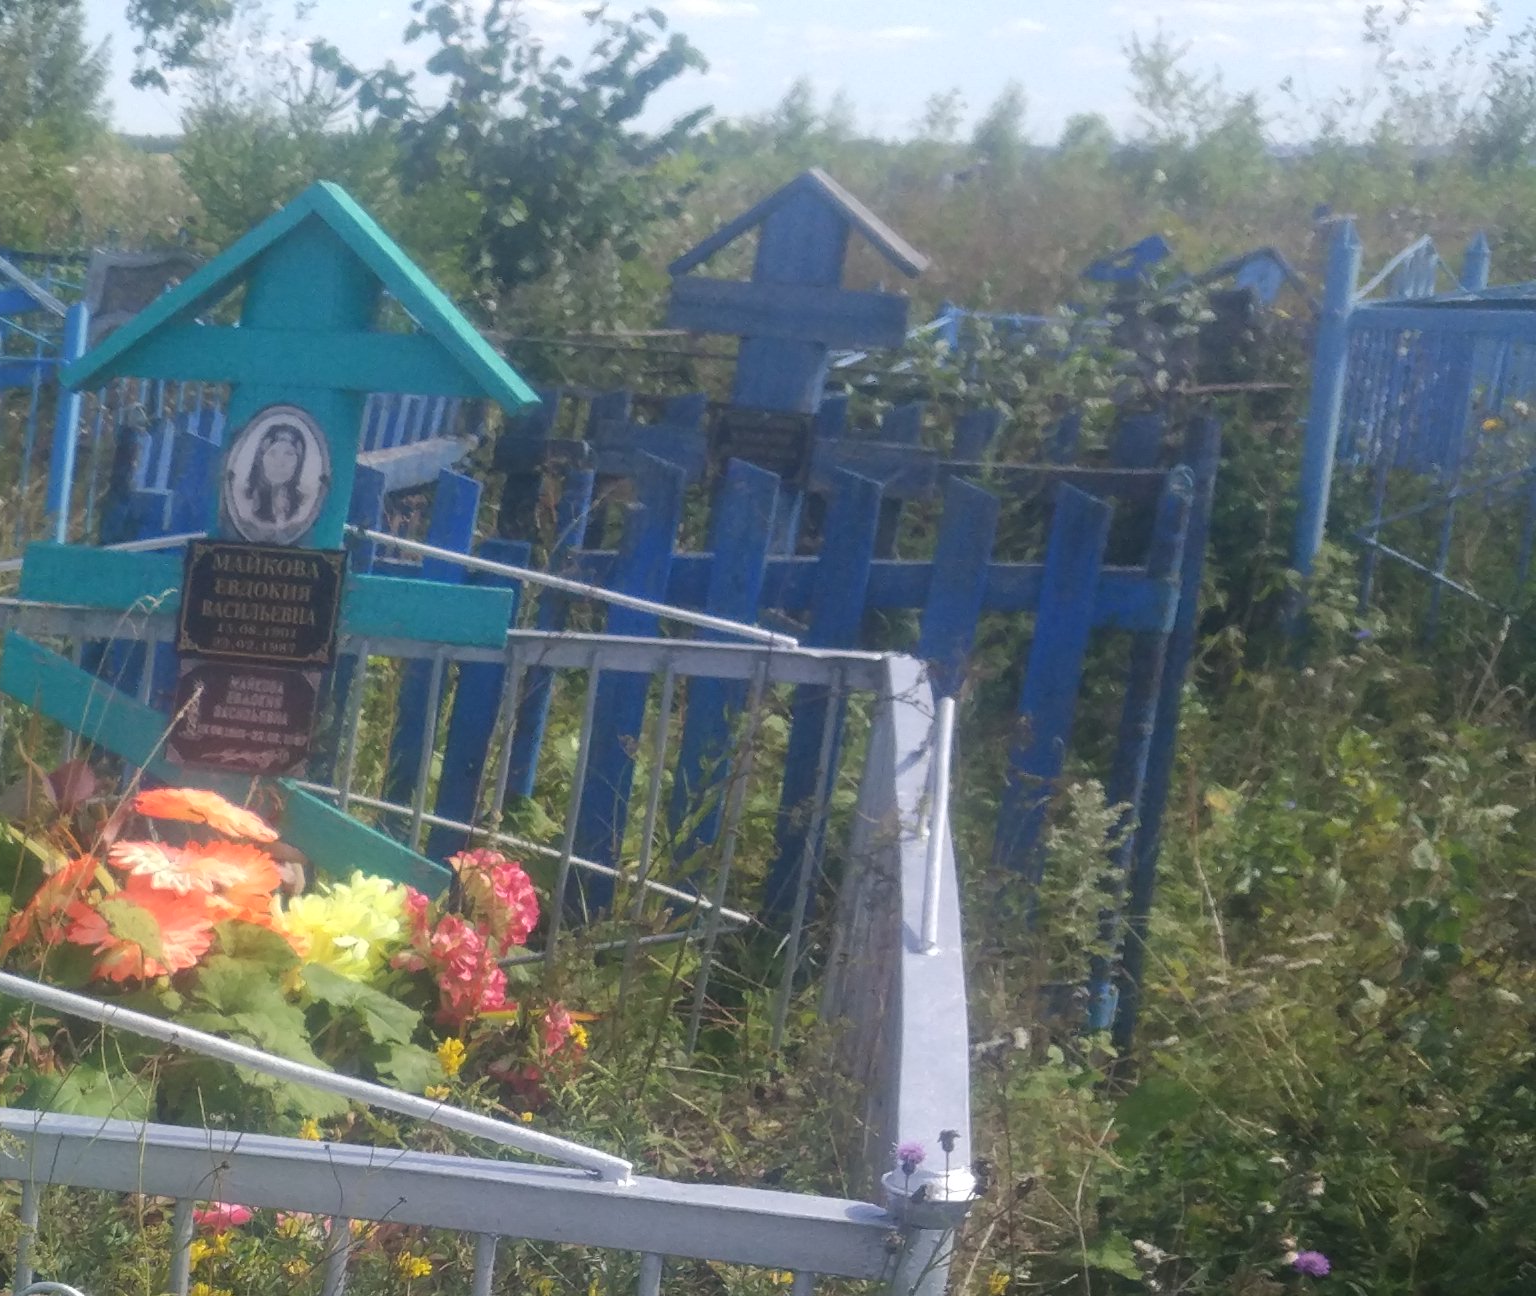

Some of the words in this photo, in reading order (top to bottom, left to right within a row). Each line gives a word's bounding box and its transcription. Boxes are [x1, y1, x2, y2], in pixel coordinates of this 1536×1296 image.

[212, 552, 319, 578] МАЙКОВА
[214, 578, 312, 602] ЕВДОКИЯ
[202, 600, 315, 625] ВАСИЛЬЕВНА
